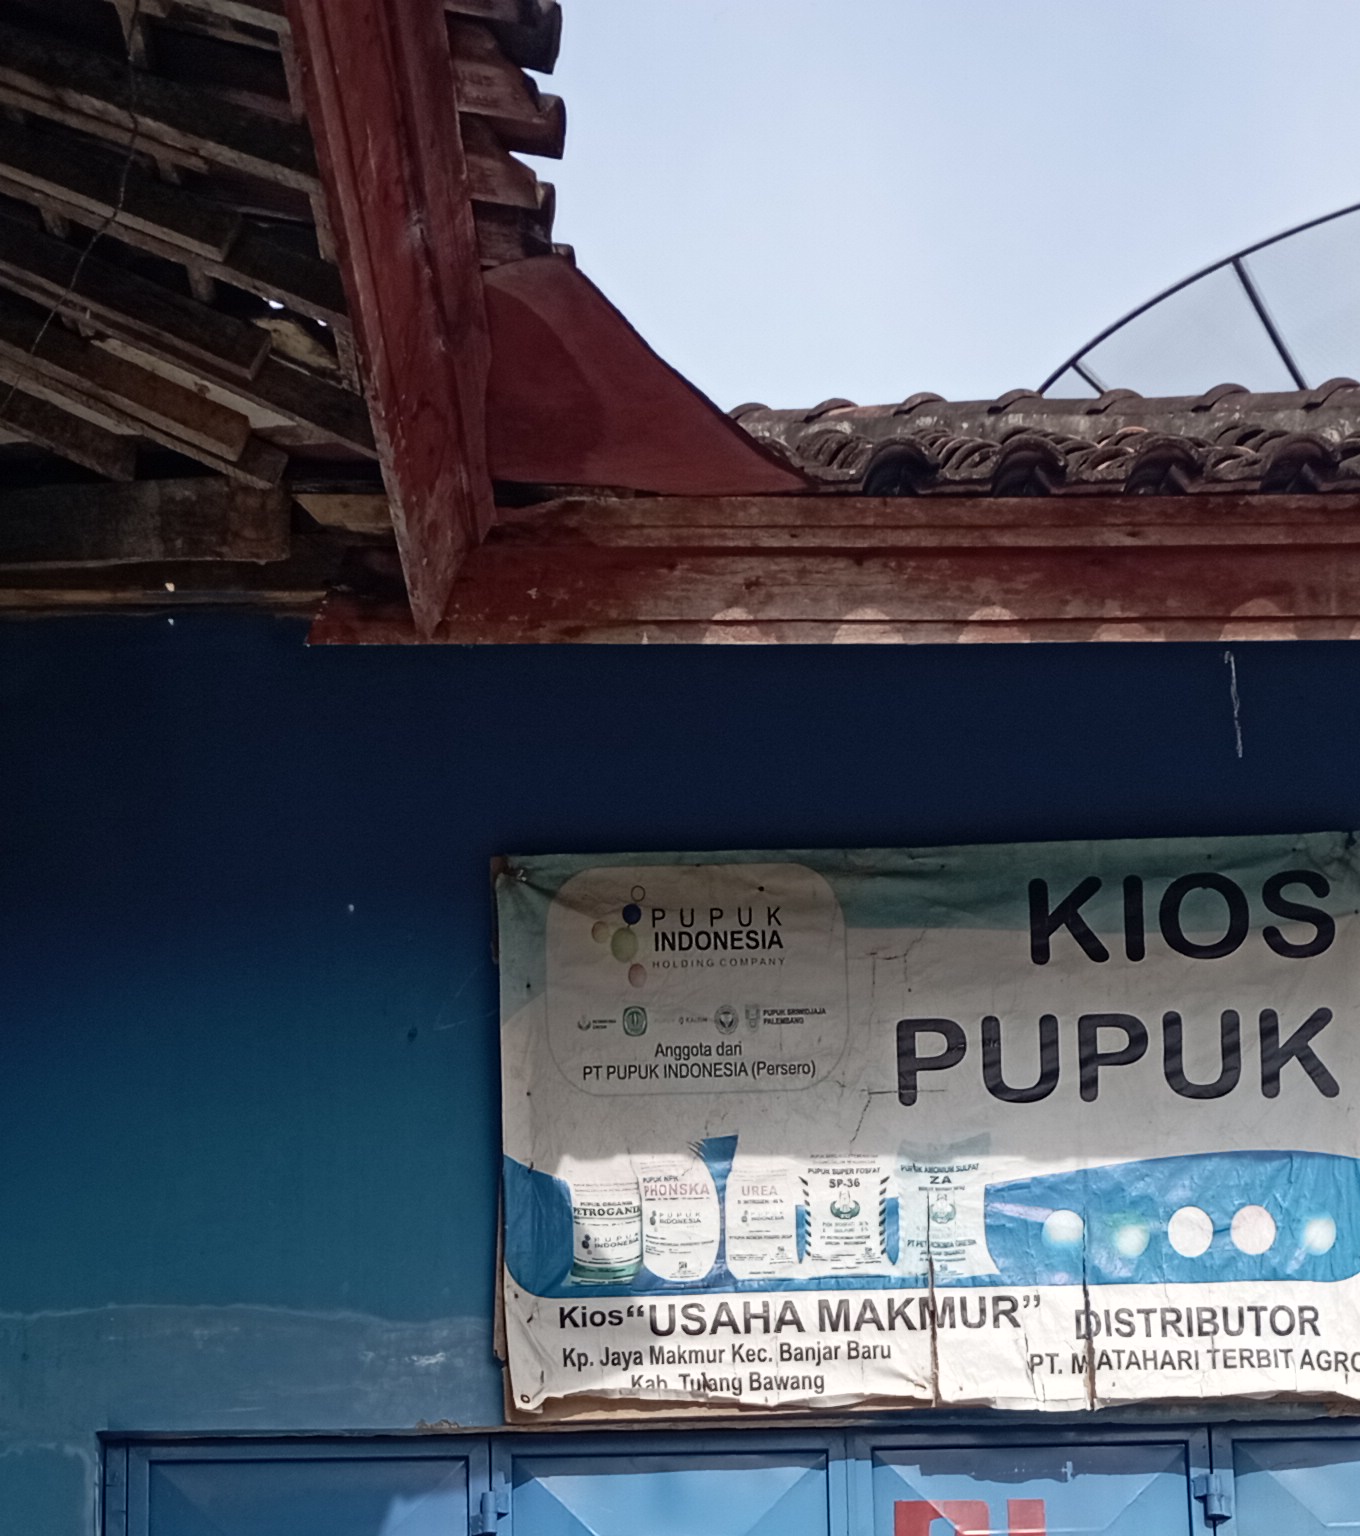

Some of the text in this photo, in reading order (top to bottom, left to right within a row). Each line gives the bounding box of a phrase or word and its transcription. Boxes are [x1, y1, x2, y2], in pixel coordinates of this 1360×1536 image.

[651, 906, 783, 928] PUPUK
[1028, 869, 1336, 966] KIOS
[654, 929, 784, 952] INDONESIA
[652, 956, 786, 969] HOLDING COMPANY
[654, 1040, 743, 1061] Anggota dari
[896, 1006, 1341, 1108] PUPUK
[583, 1059, 817, 1081] PT PUPUK INDONESIA (Persero)
[643, 1183, 710, 1197] PHONSKA
[741, 1185, 778, 1196] UREA
[829, 1178, 861, 1188] SP-36
[930, 1175, 952, 1185] ZA
[559, 1305, 623, 1329] Kios
[1075, 1305, 1322, 1340] DISTRIBUTOR
[562, 1340, 891, 1371] Kp. Jaya Makmur Kec. Banjar Baru
[1029, 1353, 1063, 1374] PT.
[1071, 1349, 1200, 1375] MATAHARI
[1207, 1347, 1293, 1370] TERBIT
[749, 1371, 825, 1395] Bawang
